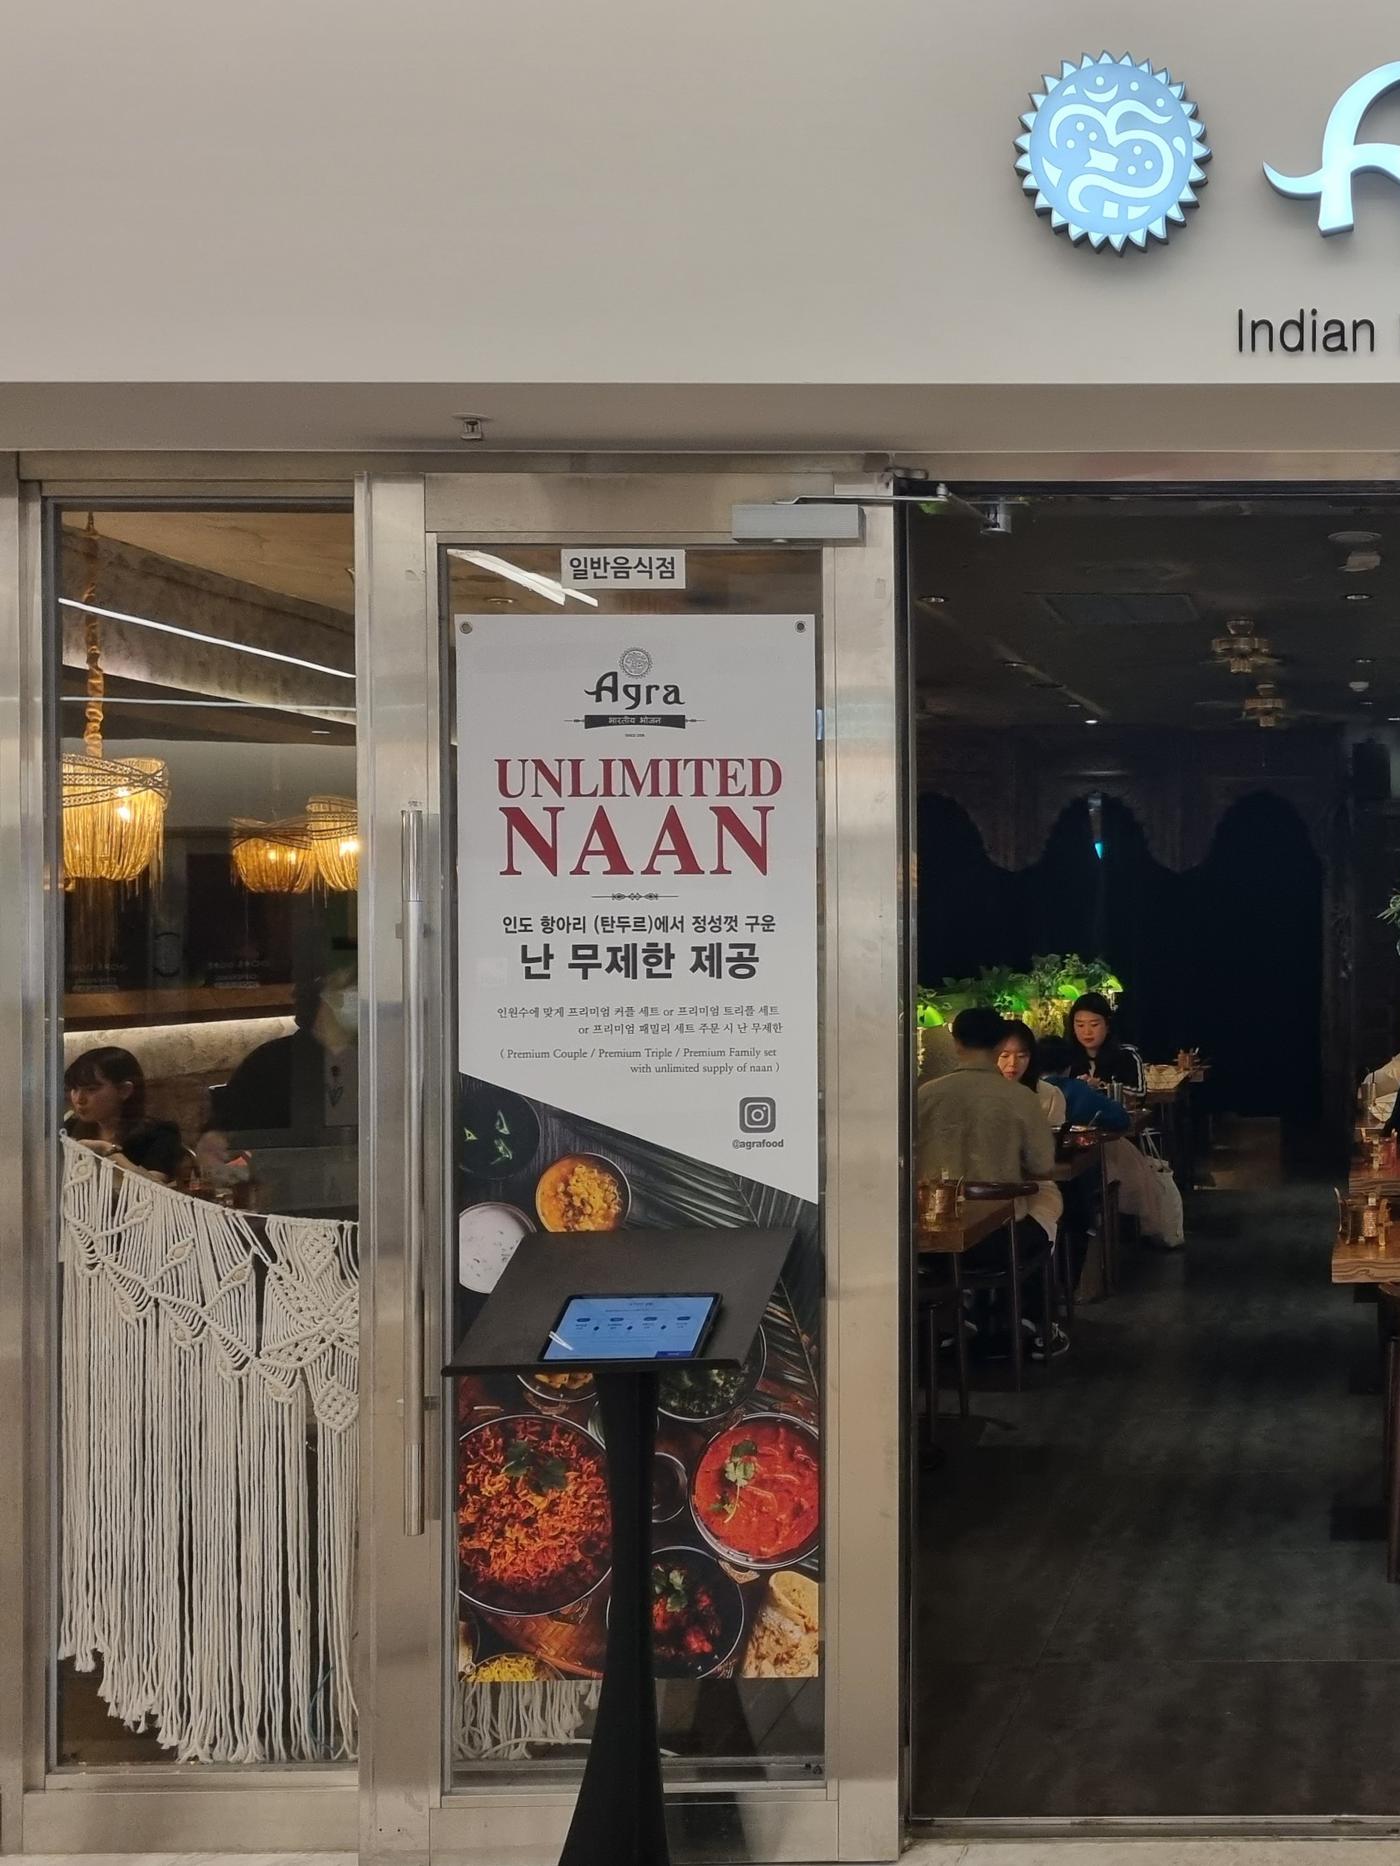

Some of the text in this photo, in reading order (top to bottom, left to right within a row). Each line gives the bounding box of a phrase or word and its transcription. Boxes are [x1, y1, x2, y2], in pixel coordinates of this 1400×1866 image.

[1238, 308, 1375, 353] Indian
[569, 556, 675, 580] 일반음식점
[583, 671, 686, 710] Agra
[493, 758, 782, 799] UNLIMITED
[498, 804, 775, 877] NAAN
[502, 914, 776, 935] 인도 항아리 (탄두르)에서 정성껏 구운
[521, 942, 760, 981] 난 무제한 제공
[496, 1004, 780, 1019] 인원수에 맞게 프리미엄 커플 세트 or 프리미엄 트리플 세트
[578, 1022, 784, 1035] or 프리미엄 패밀리 세트 주문 시 난 무제한
[507, 1049, 550, 1059] Premium
[552, 1047, 588, 1061] Couple
[598, 1048, 642, 1058] Premium
[643, 1047, 673, 1061] Triple
[683, 1047, 726, 1058] Premium
[729, 1047, 761, 1059] Family
[763, 1049, 777, 1057] set
[630, 1063, 652, 1073] with
[654, 1062, 700, 1073] unlimited
[702, 1062, 734, 1075] supply
[736, 1062, 748, 1073] of
[749, 1065, 773, 1073] naan
[732, 1138, 784, 1151] @agrafood
